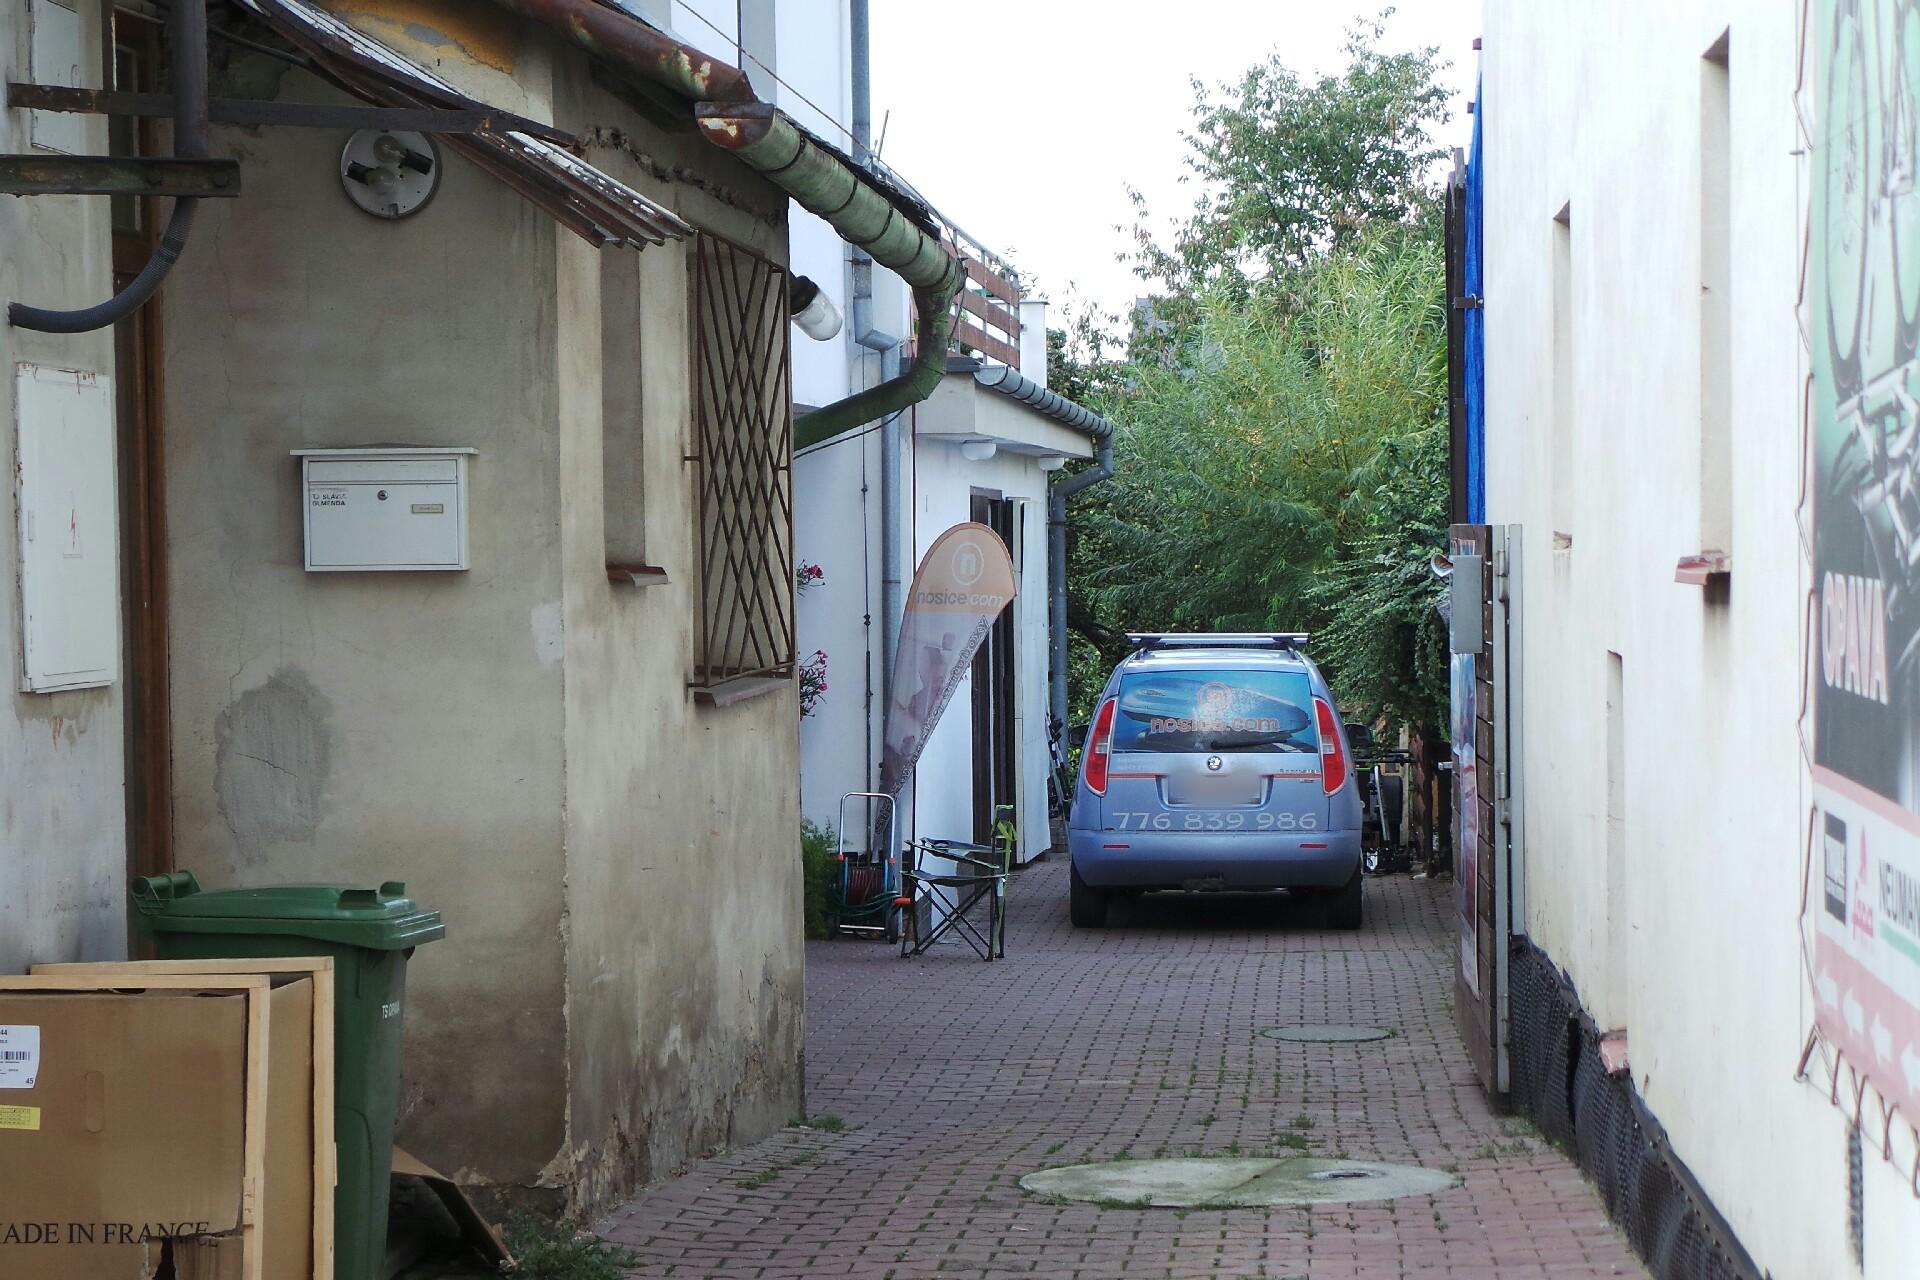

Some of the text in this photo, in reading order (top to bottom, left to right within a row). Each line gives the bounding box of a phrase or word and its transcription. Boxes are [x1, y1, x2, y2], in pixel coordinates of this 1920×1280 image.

[916, 588, 1003, 609] nosice.com
[1822, 569, 1888, 705] OPAVA
[1112, 812, 1318, 829] 776 839 986
[381, 1004, 389, 1019] TS
[25, 1077, 34, 1085] 45
[0, 1222, 60, 1244] ADE
[67, 1222, 95, 1244] IN
